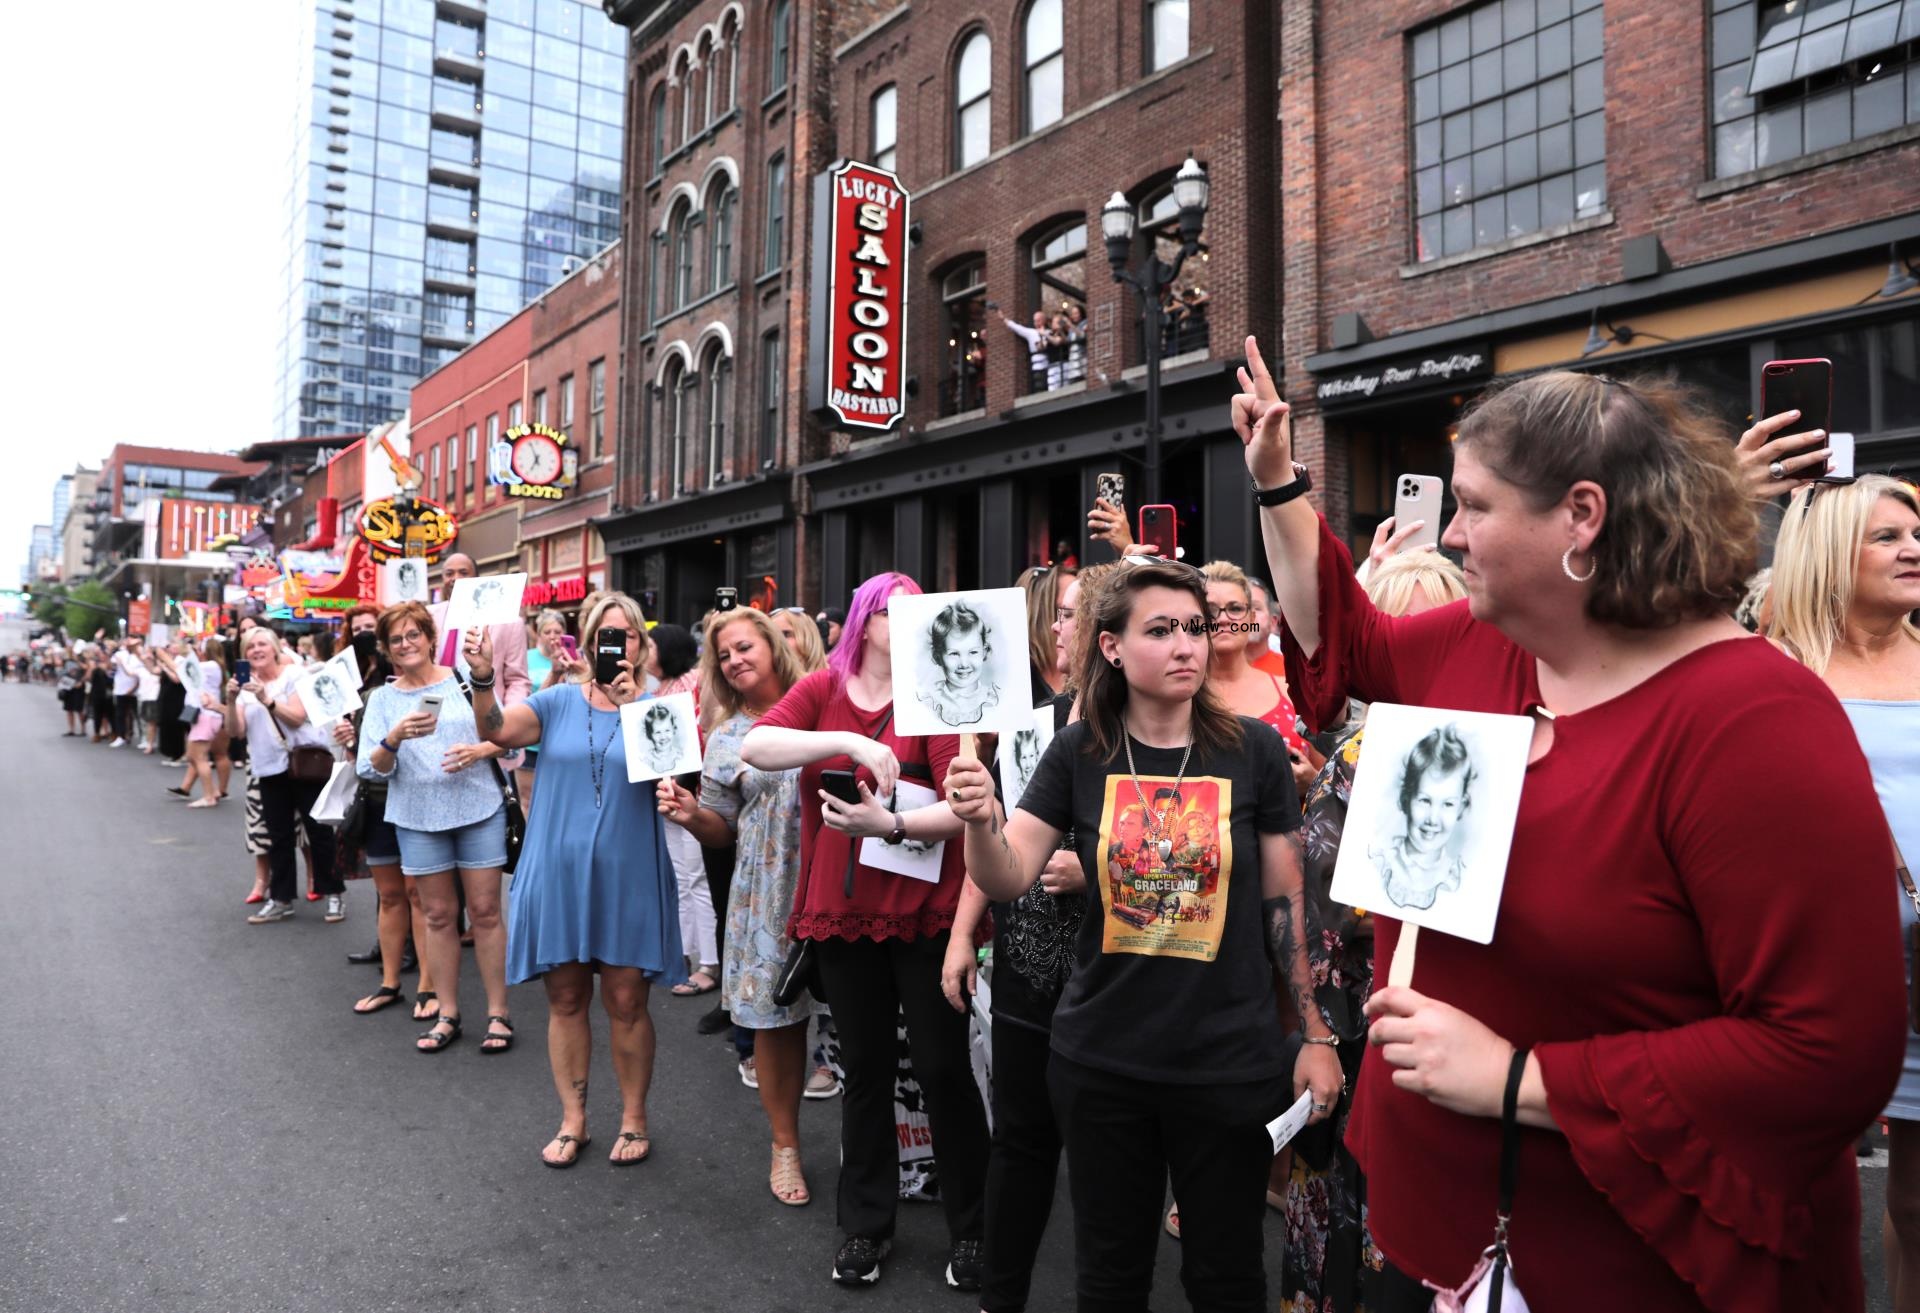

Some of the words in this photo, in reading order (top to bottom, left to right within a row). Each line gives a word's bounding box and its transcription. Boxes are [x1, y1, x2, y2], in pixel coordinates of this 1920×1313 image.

[839, 177, 901, 210] LUCKY
[852, 202, 890, 393] SALOON
[833, 387, 898, 414] BASTARD
[506, 423, 531, 440] BIG
[533, 422, 567, 446] TIME
[510, 484, 563, 500] BOOTS
[1134, 879, 1198, 892] GRACELAND
